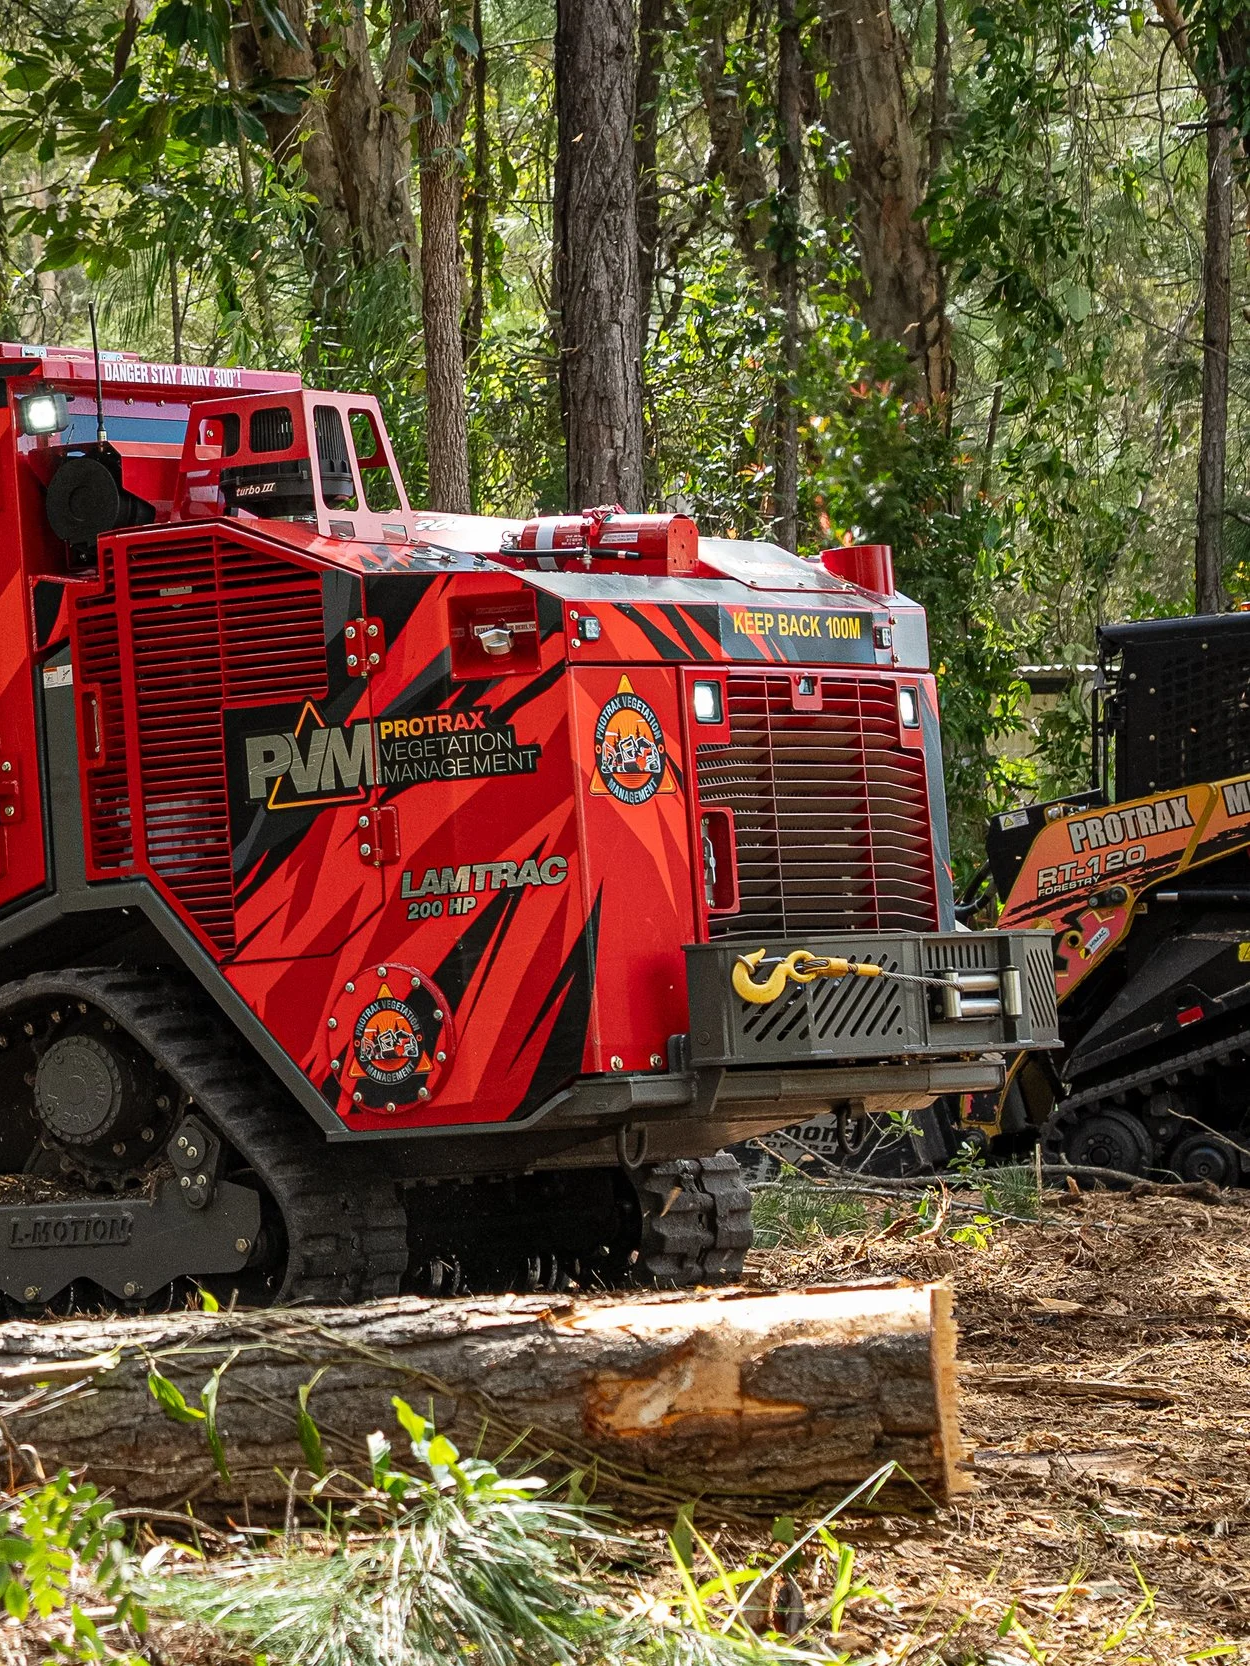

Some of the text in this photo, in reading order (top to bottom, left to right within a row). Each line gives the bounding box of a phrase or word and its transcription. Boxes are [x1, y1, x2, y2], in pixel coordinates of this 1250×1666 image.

[104, 363, 149, 383] DANGER
[151, 365, 177, 384] STAY
[180, 367, 211, 386] AWAY
[236, 482, 276, 497] turbo III
[733, 612, 861, 639] KEEP BACK 100M
[380, 711, 486, 739] PROTRAX
[596, 695, 662, 740] PROTRAX VEGETATION
[381, 732, 513, 761] VEGETATION
[245, 723, 382, 799] PVM
[384, 750, 538, 784] MANAGEMENT
[608, 777, 658, 803] MANAGEMENT
[1068, 796, 1195, 853] PROTRAX
[401, 856, 568, 899] LAMTRAC
[1038, 845, 1146, 888] RT-120
[1038, 875, 1101, 897] FORESTRY
[408, 896, 477, 920] 200 HP
[355, 1000, 421, 1036] PROTRAX VEGETATION
[366, 1062, 417, 1083] MANAGEMENT
[10, 1219, 133, 1244] L-MOTION
